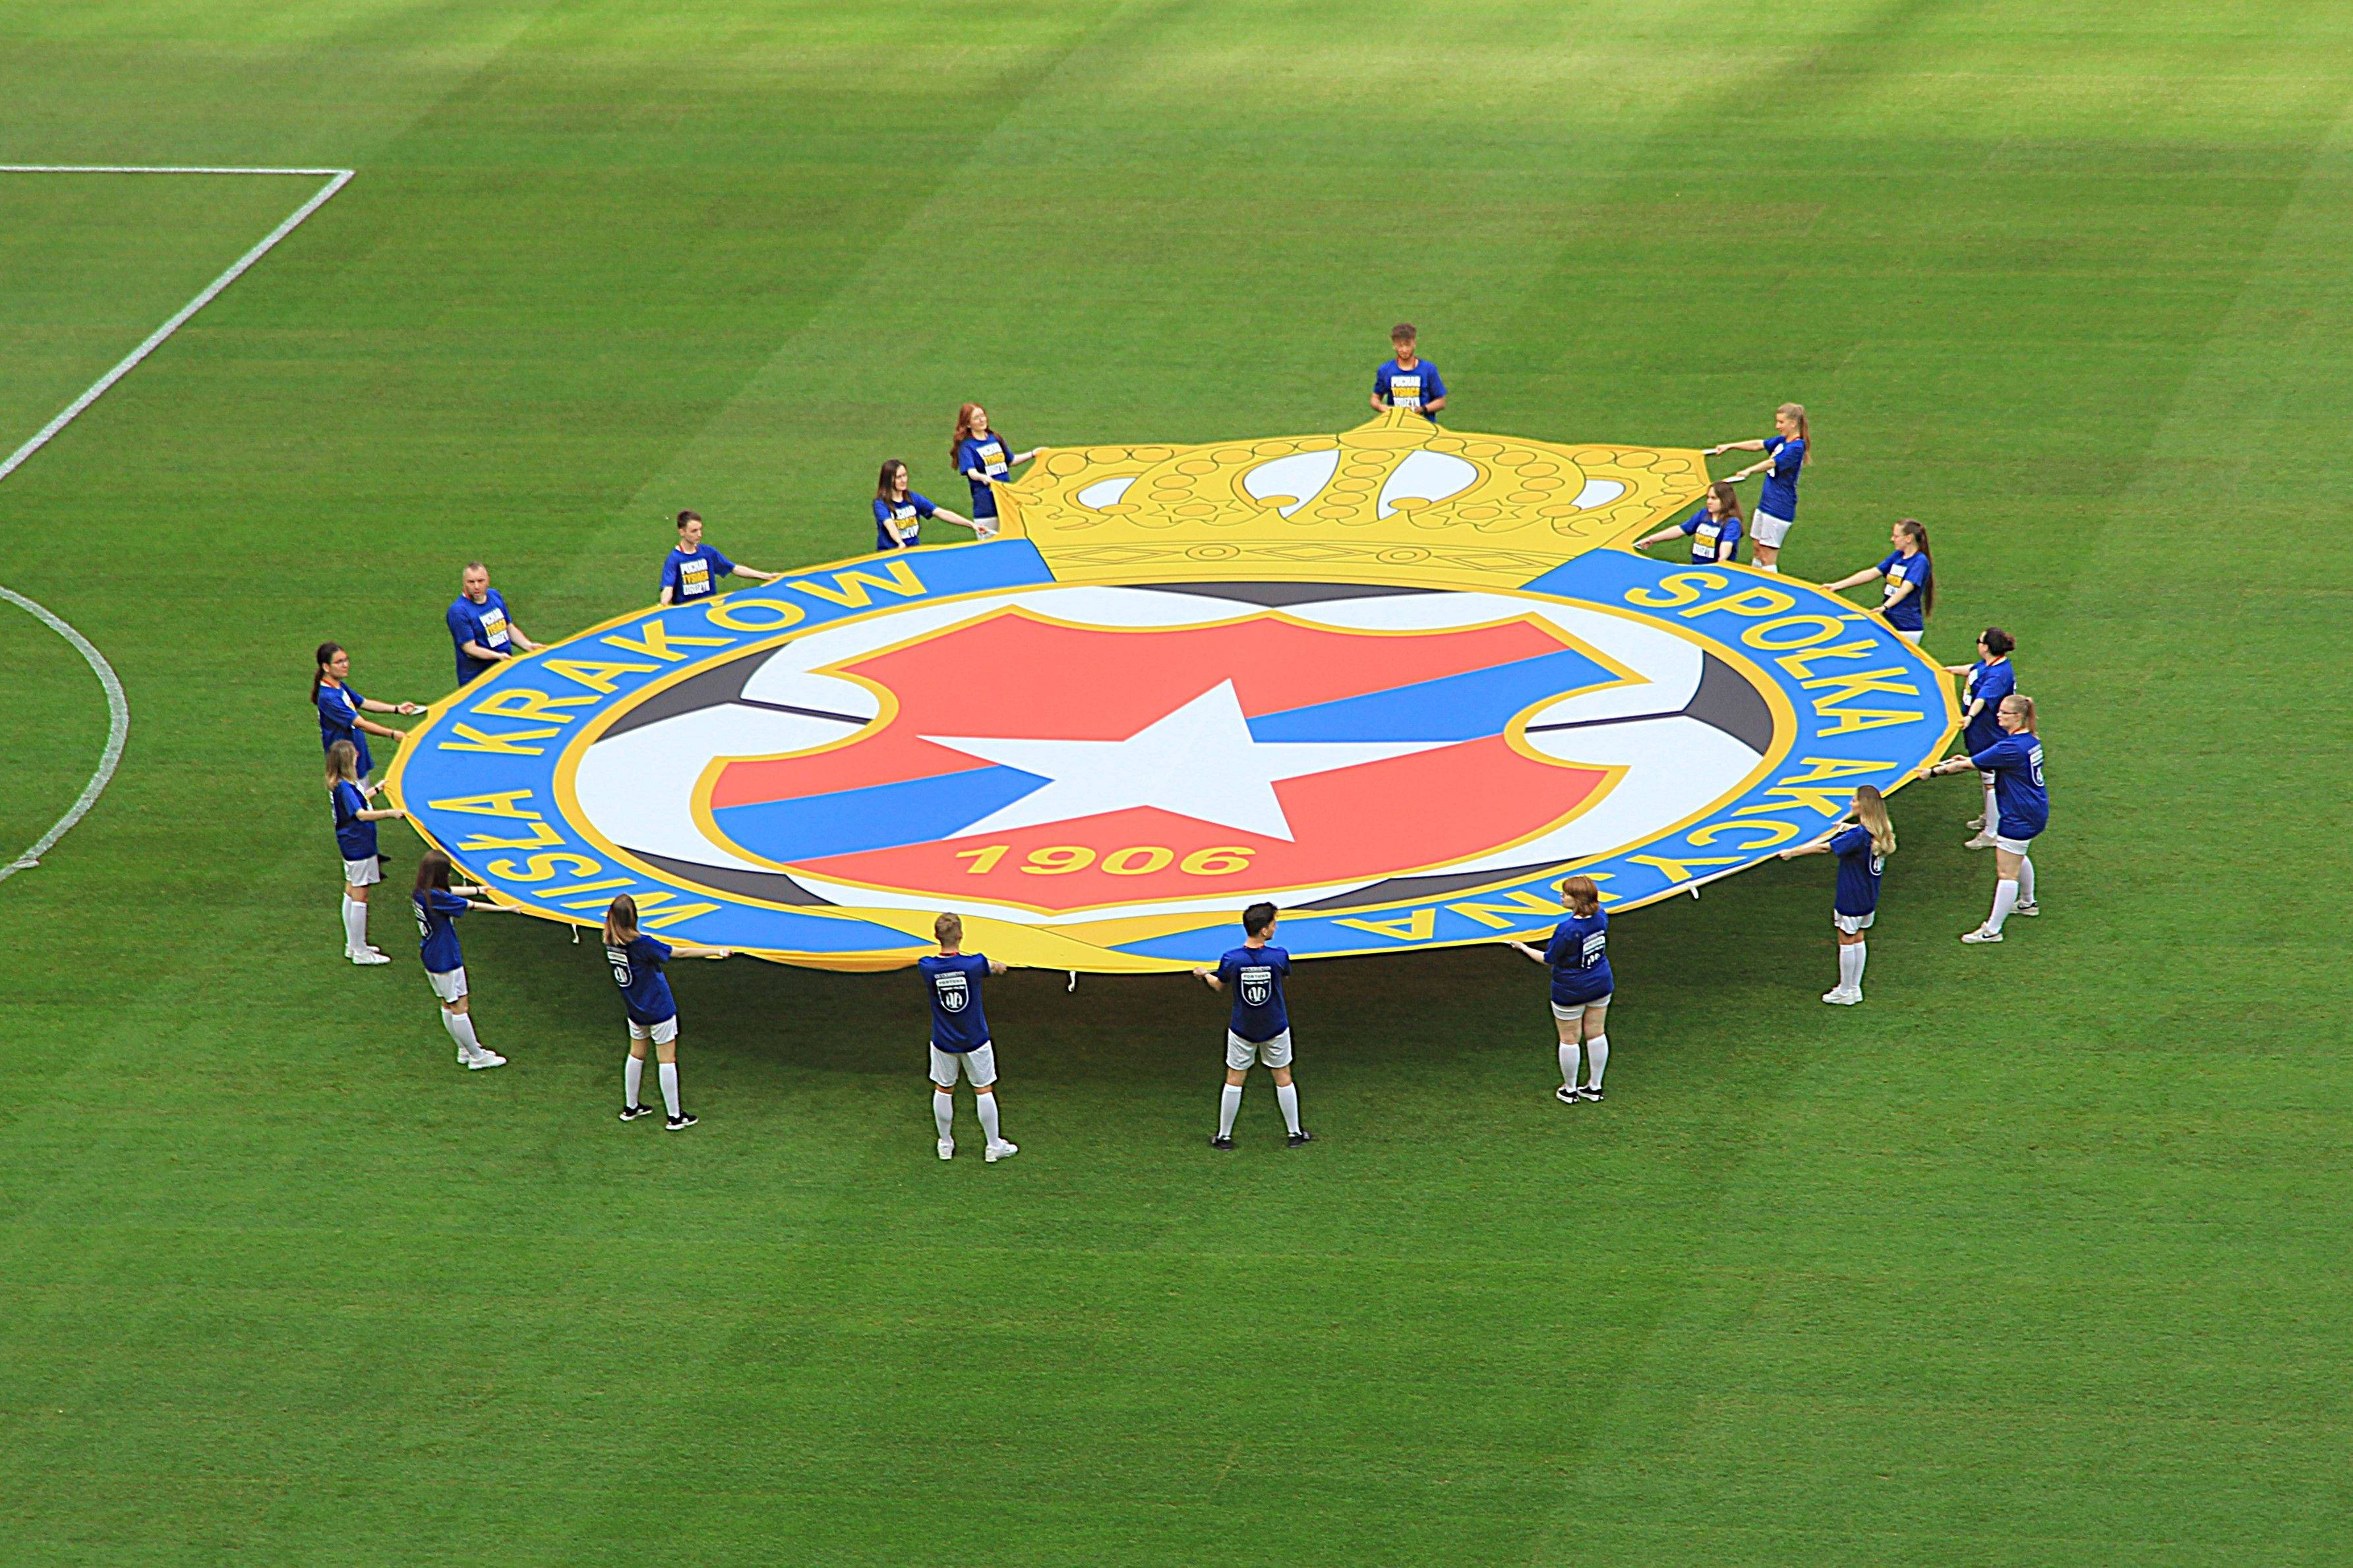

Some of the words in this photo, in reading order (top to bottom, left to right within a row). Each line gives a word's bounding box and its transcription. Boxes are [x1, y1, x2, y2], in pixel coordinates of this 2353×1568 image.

[438, 560, 927, 756] KRAKÓW
[1624, 572, 1924, 738] SPÓŁKA
[428, 789, 722, 929] WISŁA
[955, 845, 1257, 875] 1906
